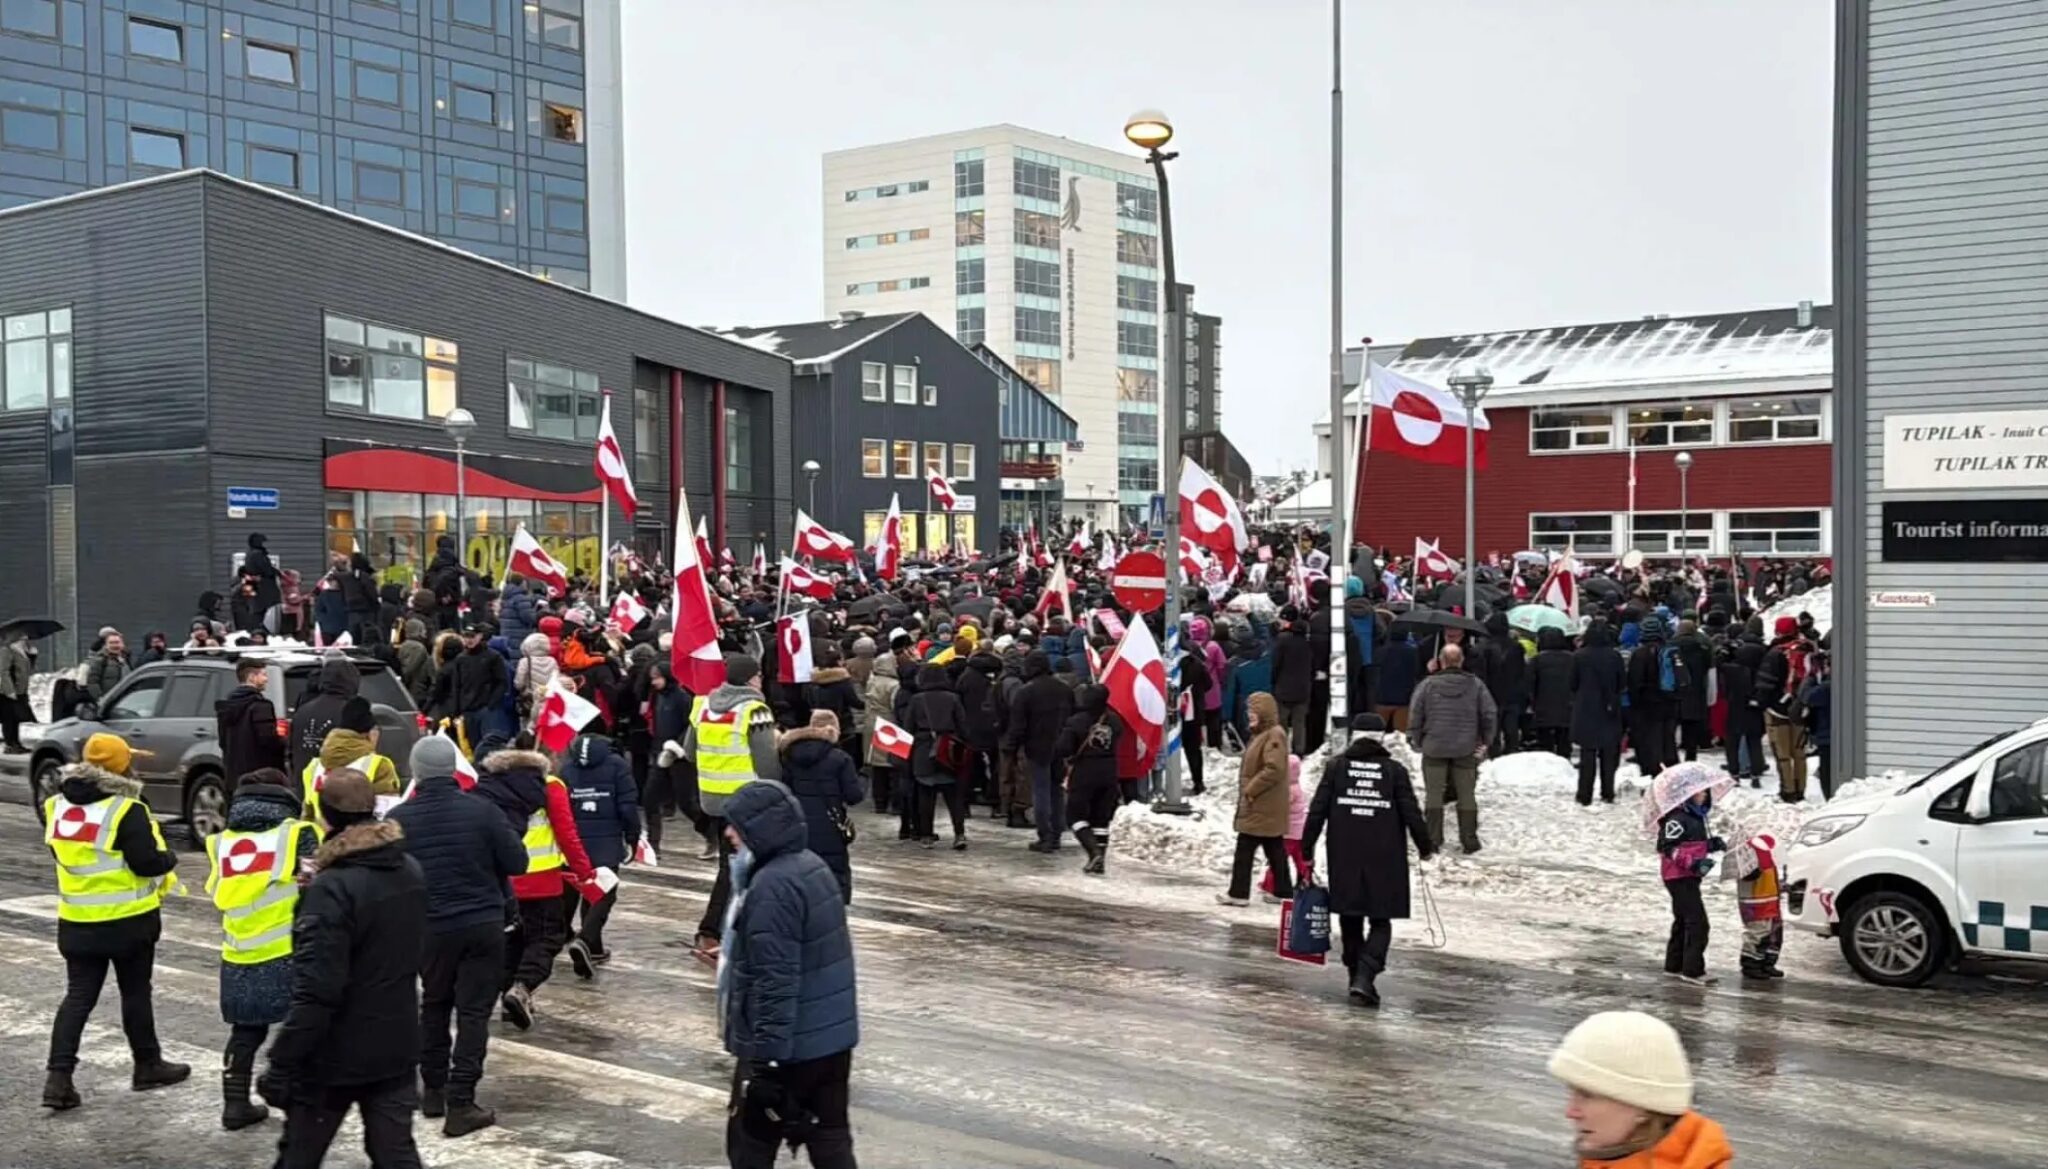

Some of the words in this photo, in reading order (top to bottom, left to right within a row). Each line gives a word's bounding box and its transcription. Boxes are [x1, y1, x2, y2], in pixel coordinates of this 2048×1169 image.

[1902, 425, 1985, 441] TUPILAK
[2003, 427, 2035, 438] Inuit
[1934, 456, 2018, 472] TUPILAK
[2024, 455, 2048, 470] TR
[1892, 521, 1964, 538] Tourist
[1350, 760, 1381, 769] TRUMP
[1348, 769, 1382, 779] VOTERS
[1346, 788, 1382, 798] ILLEGAL
[1337, 797, 1391, 808] IMMIGRANTS
